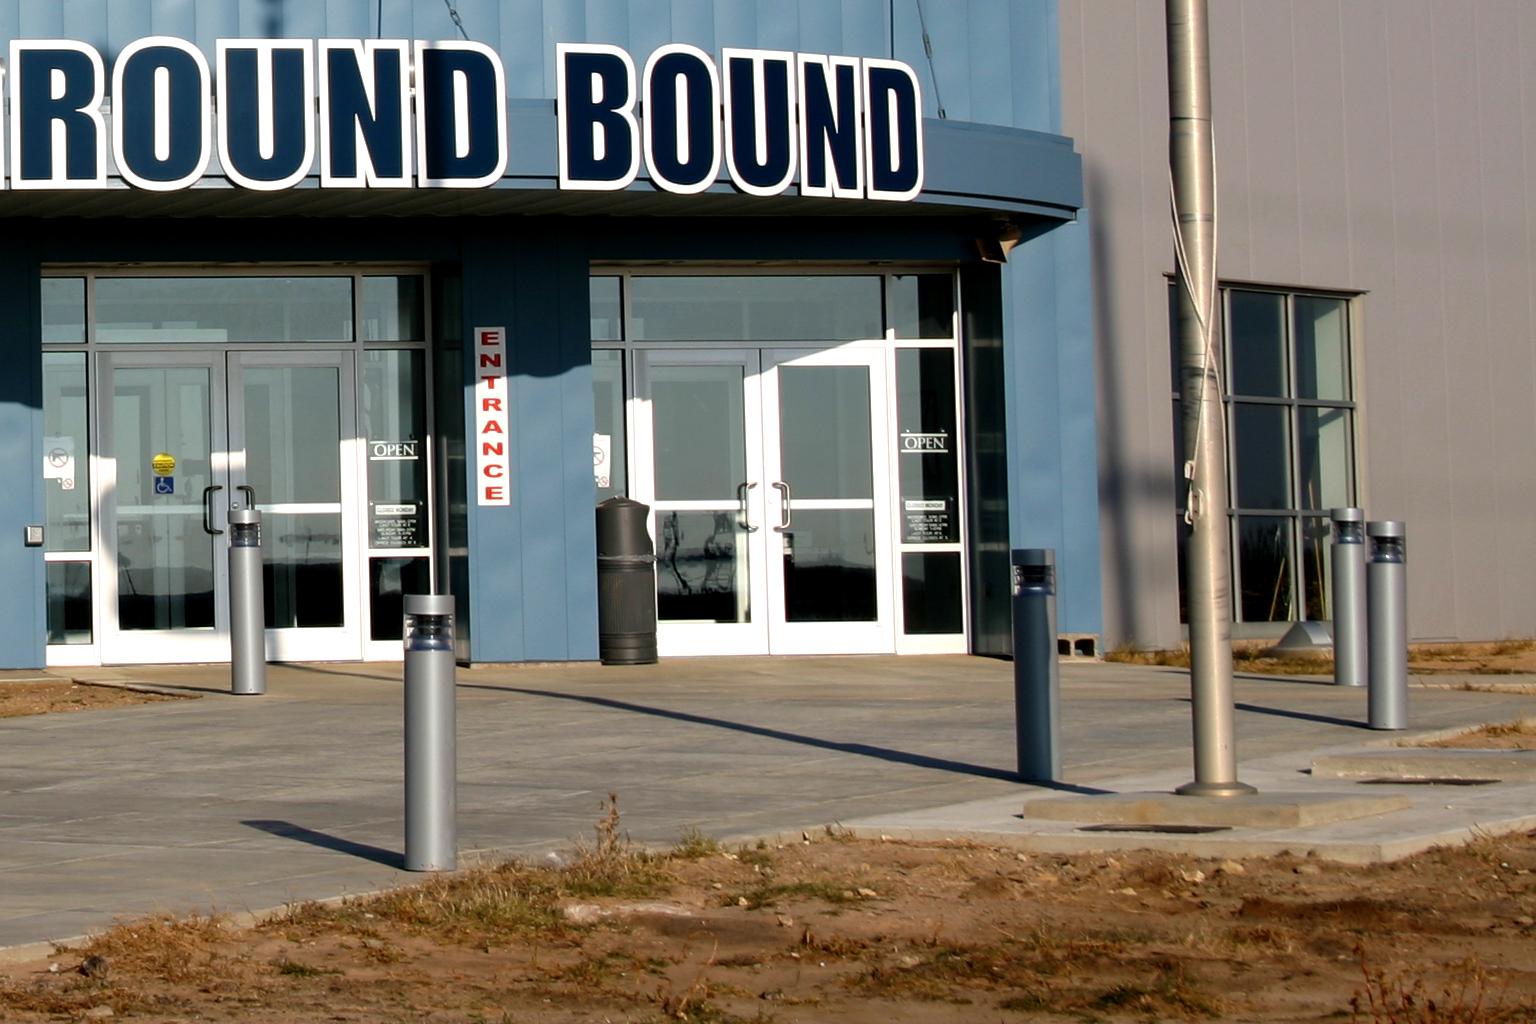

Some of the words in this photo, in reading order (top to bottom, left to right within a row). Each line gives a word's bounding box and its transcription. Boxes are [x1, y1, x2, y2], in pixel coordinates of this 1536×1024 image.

[556, 43, 924, 202] BOUND
[374, 443, 415, 457] OPEN
[479, 331, 504, 500] ENTRANCE
[904, 437, 945, 450] OPEN
